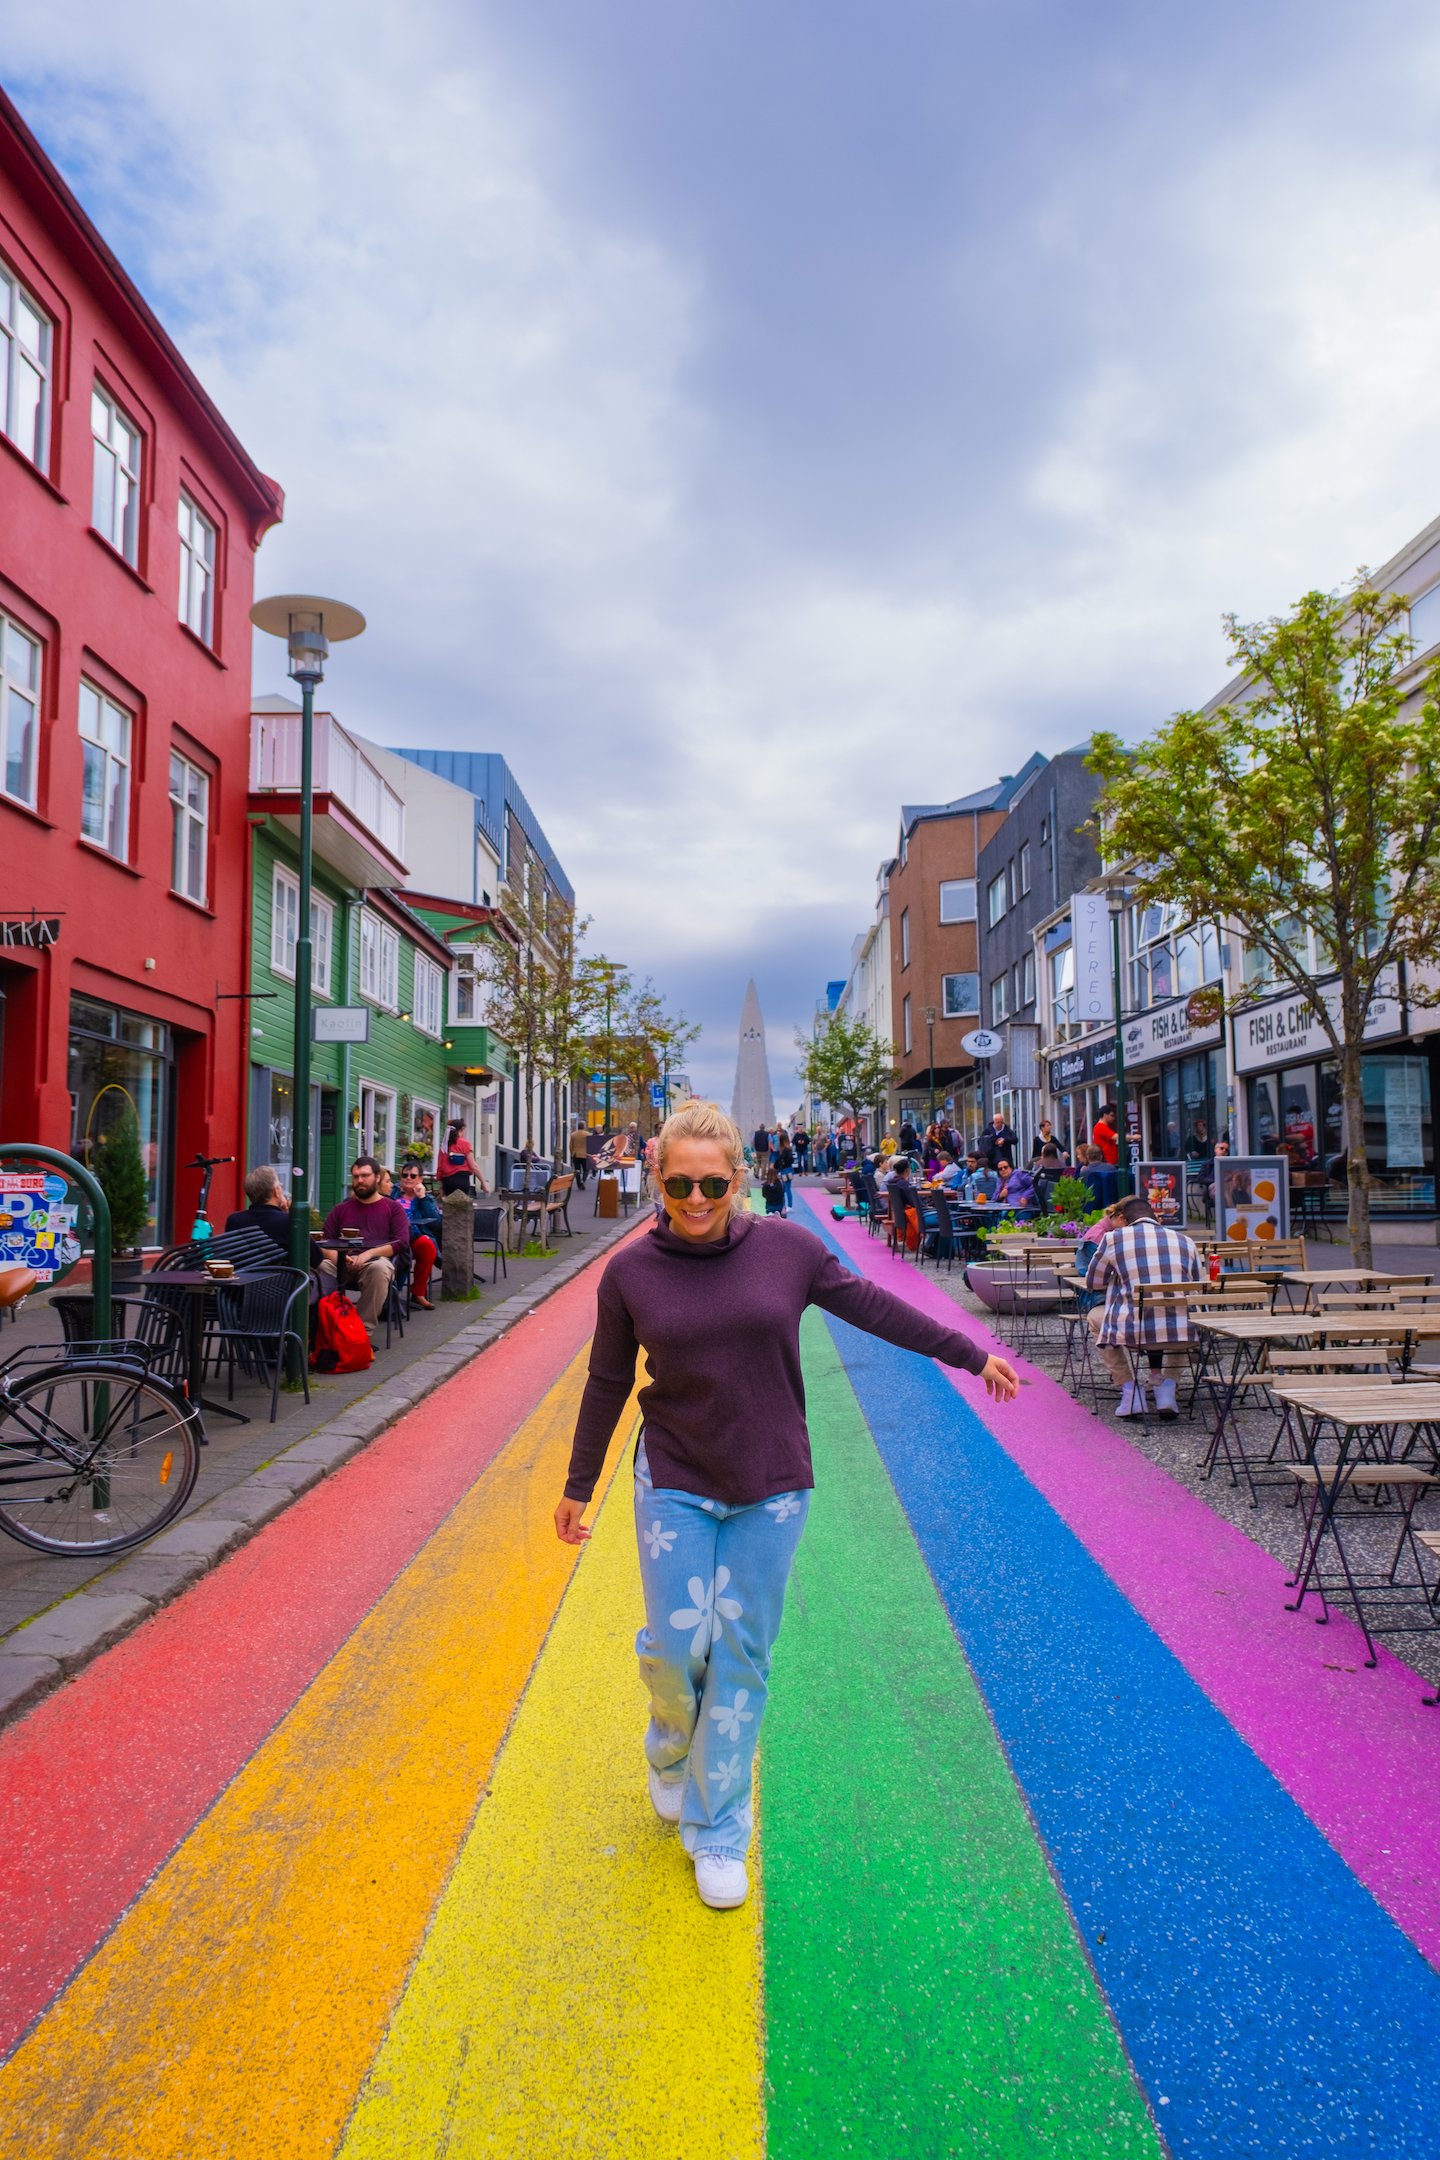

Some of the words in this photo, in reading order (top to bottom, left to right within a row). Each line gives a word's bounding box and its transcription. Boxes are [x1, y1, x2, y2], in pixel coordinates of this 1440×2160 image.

[1152, 1012, 1169, 1041] FISH
[1171, 1012, 1178, 1034] &
[1250, 1014, 1273, 1046] FISH
[1276, 1011, 1286, 1038] &
[1266, 1035, 1307, 1057] RESTAURANT
[1062, 1056, 1085, 1078] Blondie
